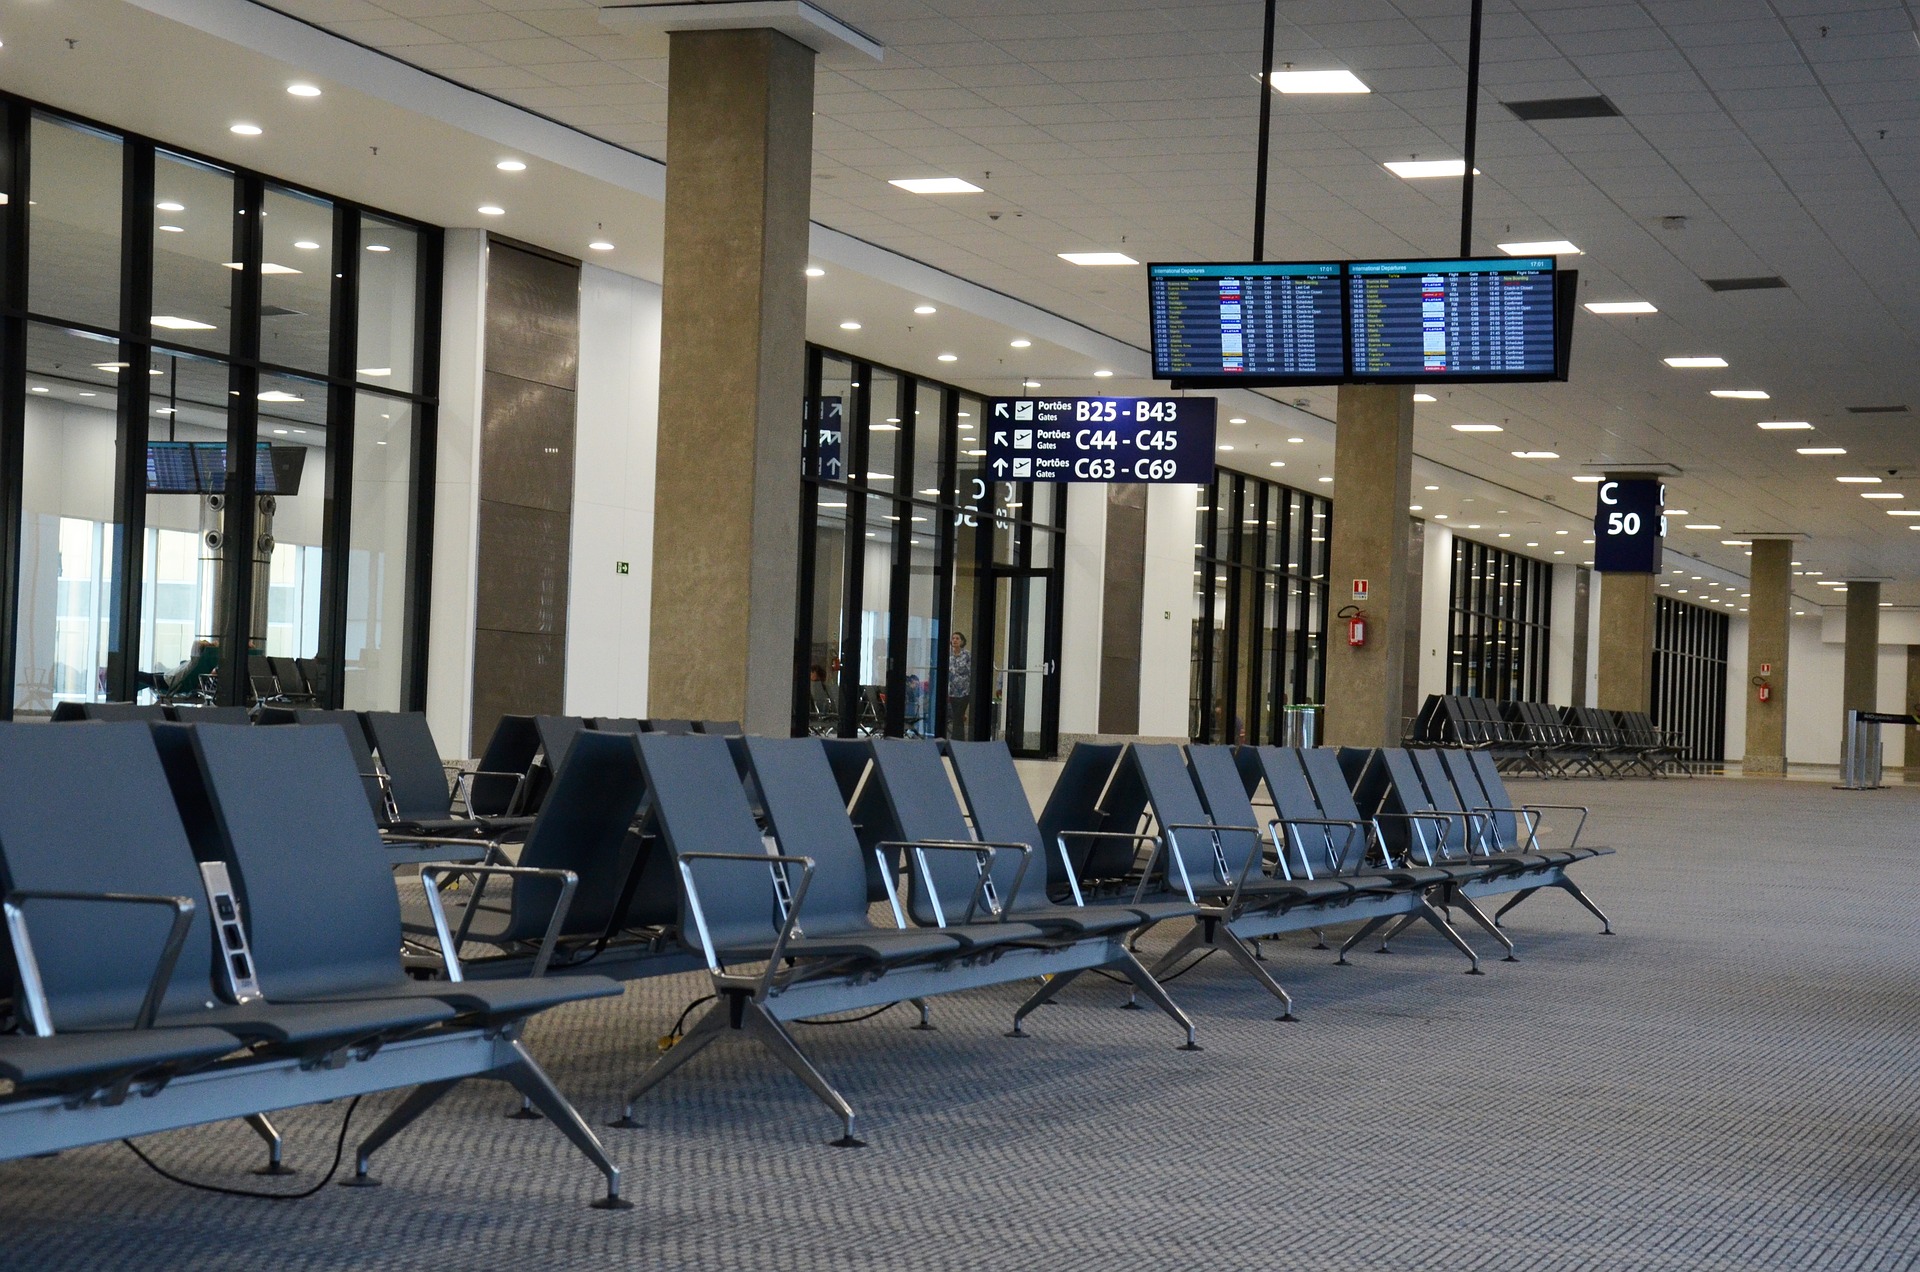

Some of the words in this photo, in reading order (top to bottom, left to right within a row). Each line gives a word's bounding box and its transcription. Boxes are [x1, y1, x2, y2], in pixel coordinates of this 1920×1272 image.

[1038, 401, 1072, 410] Portões
[1076, 401, 1117, 422] B25
[1136, 401, 1177, 422] B43
[1037, 429, 1070, 439] Portões
[1076, 429, 1117, 450] C44
[1136, 430, 1177, 450] C45
[1036, 458, 1069, 467] Portões
[1075, 458, 1115, 478] C63
[1134, 458, 1177, 479] C69
[1600, 482, 1618, 505] C
[1607, 512, 1640, 535] 50
